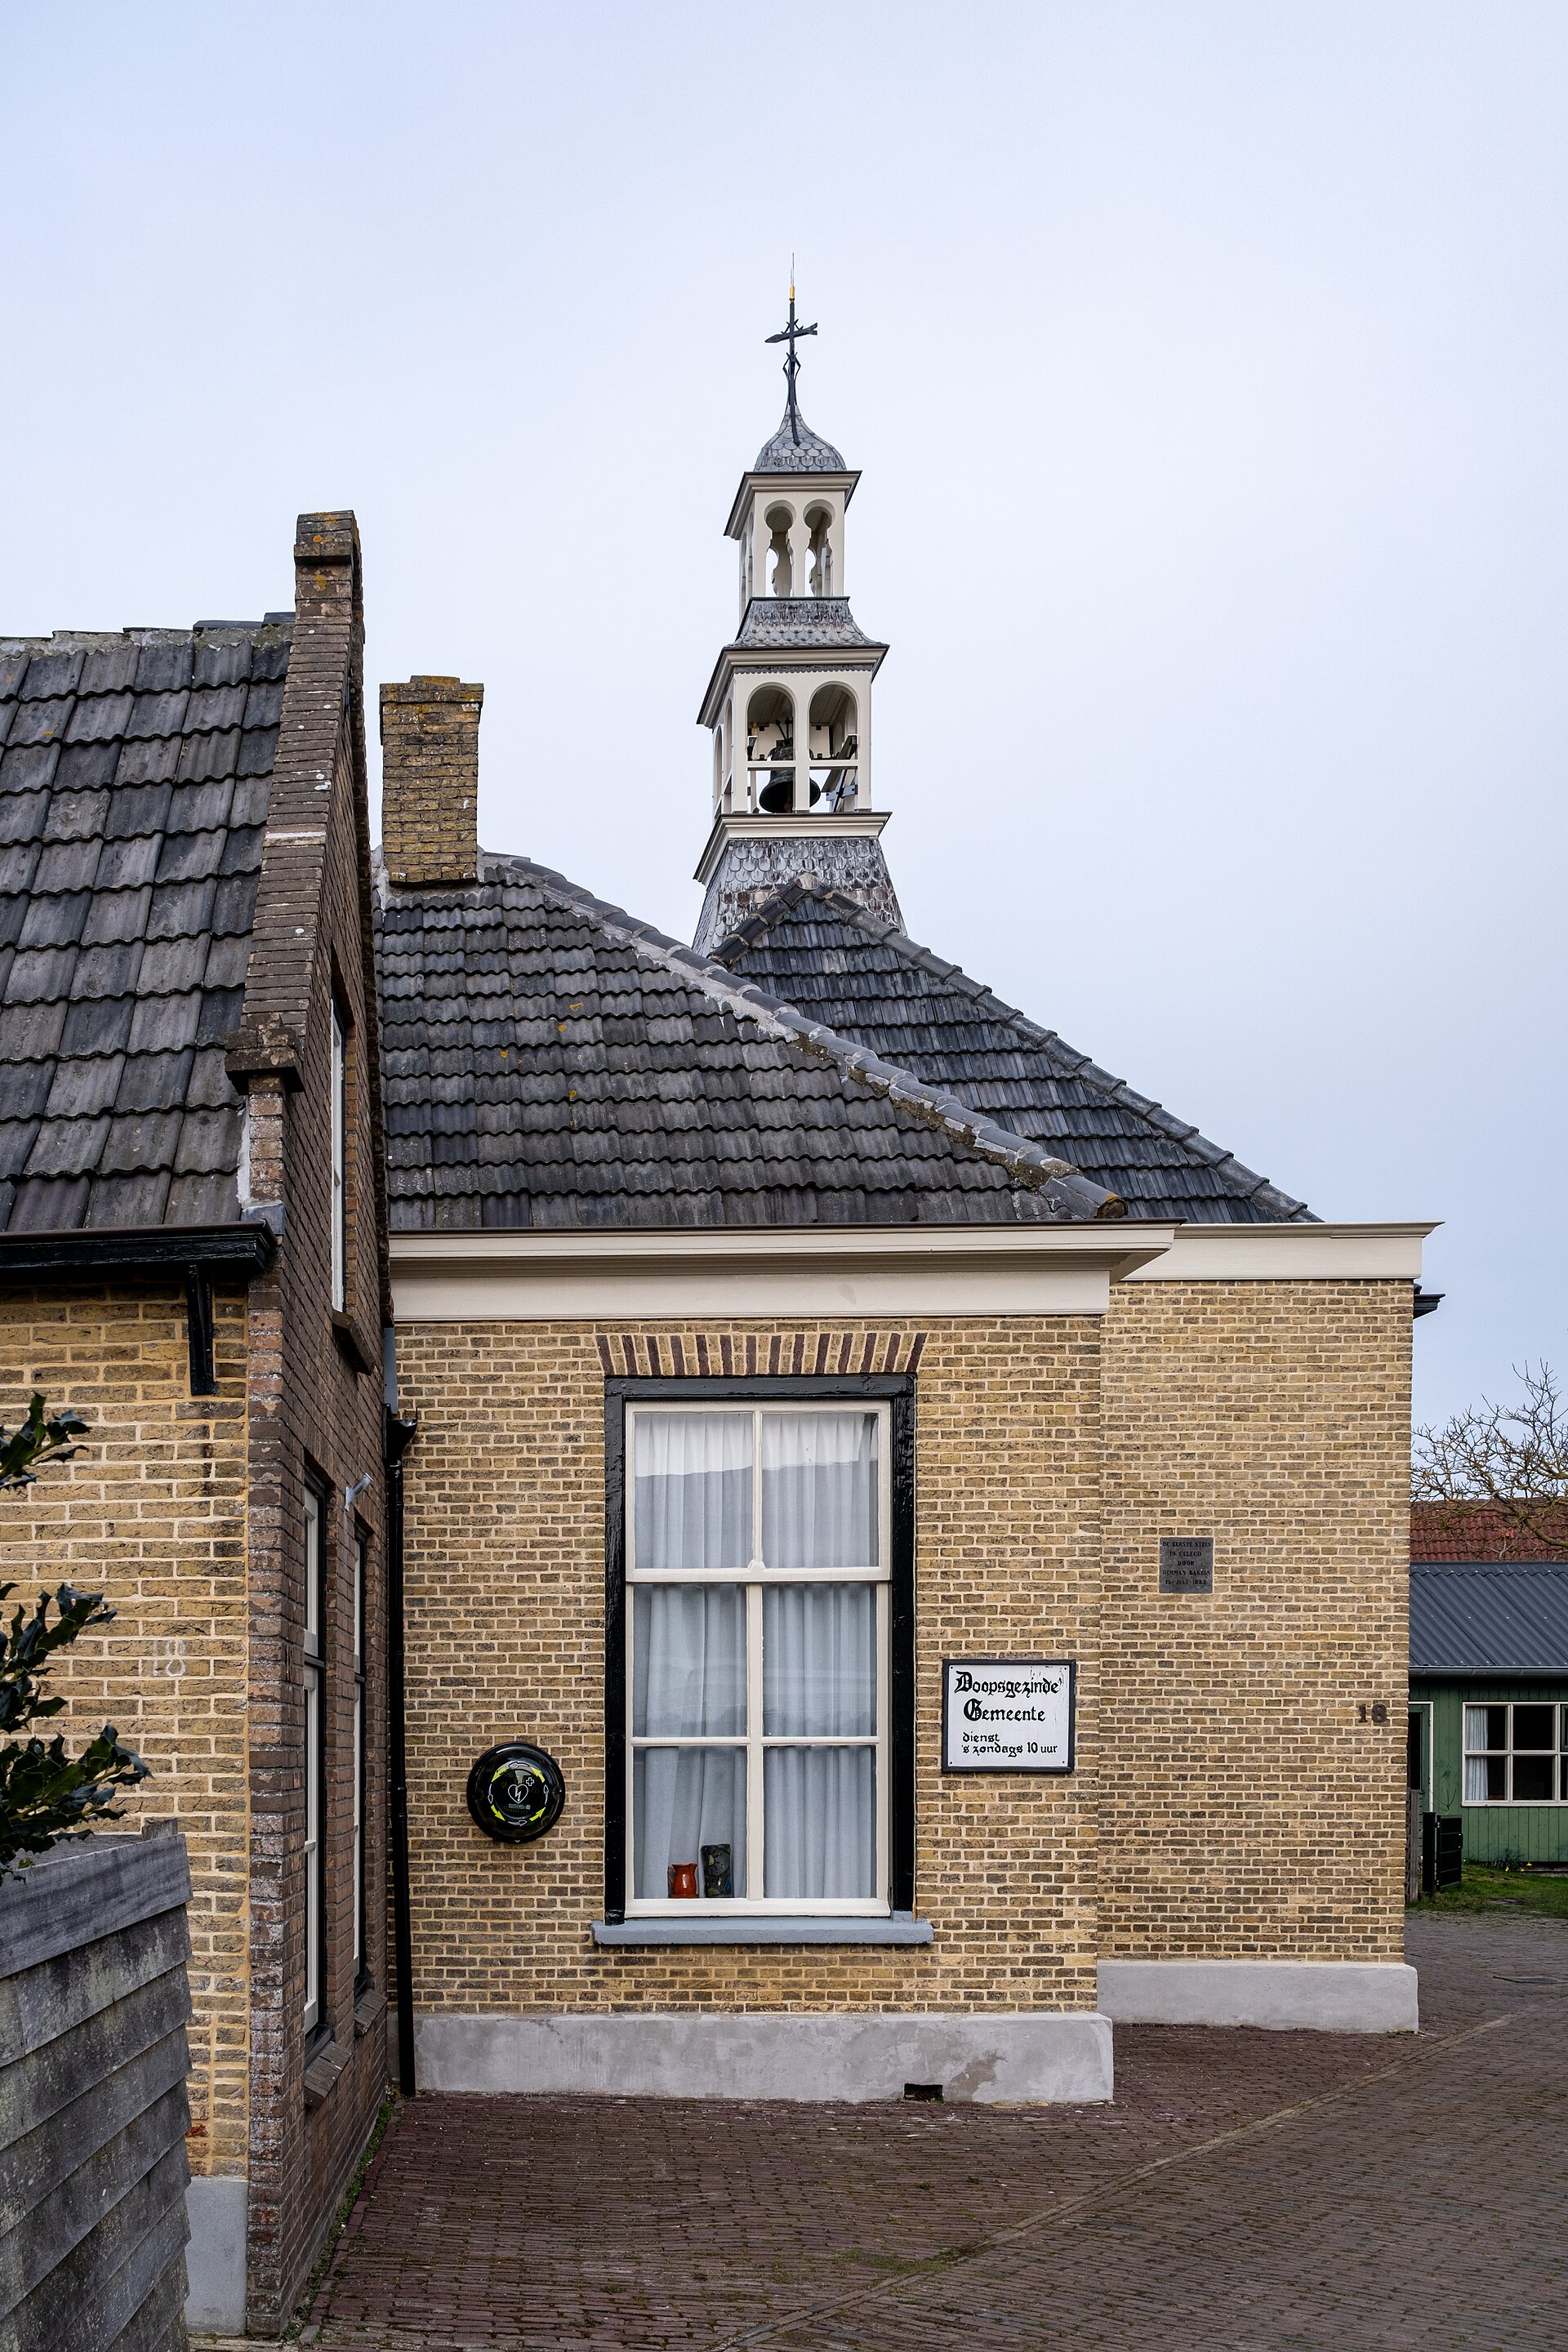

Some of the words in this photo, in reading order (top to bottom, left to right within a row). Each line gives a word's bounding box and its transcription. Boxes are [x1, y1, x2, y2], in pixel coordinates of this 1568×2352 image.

[954, 1670, 1060, 1698] Doopsgezinde
[963, 1698, 1046, 1722] Gemeente
[1358, 1703, 1387, 1723] 18
[962, 1731, 1000, 1743] dienst
[973, 1742, 1023, 1757] zondags
[1027, 1741, 1038, 1753] 10
[1040, 1744, 1058, 1753] uur
